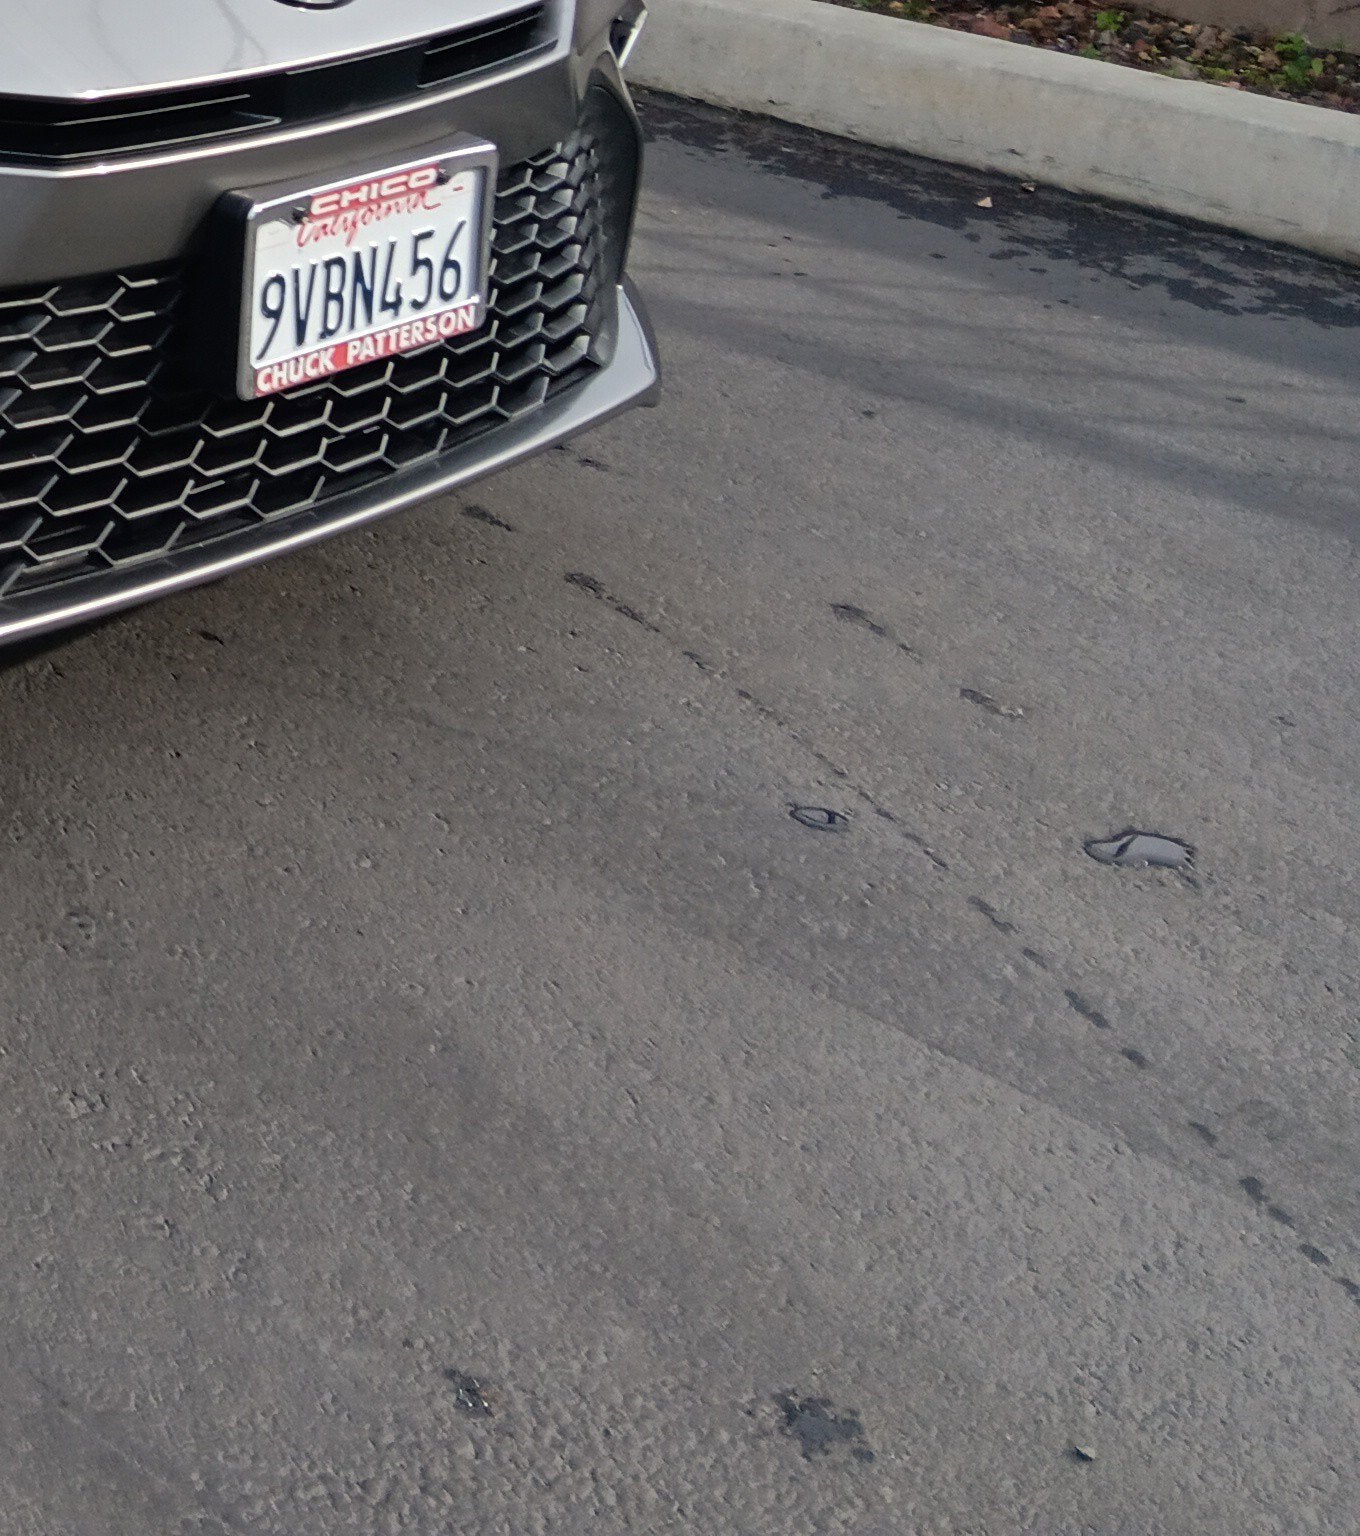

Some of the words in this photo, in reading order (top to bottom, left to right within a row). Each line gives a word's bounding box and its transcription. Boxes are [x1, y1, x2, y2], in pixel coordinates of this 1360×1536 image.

[310, 167, 438, 216] CHICO
[256, 219, 467, 361] 9VBN456
[256, 347, 336, 392] CHUCK
[346, 304, 477, 365] PATTERSON
